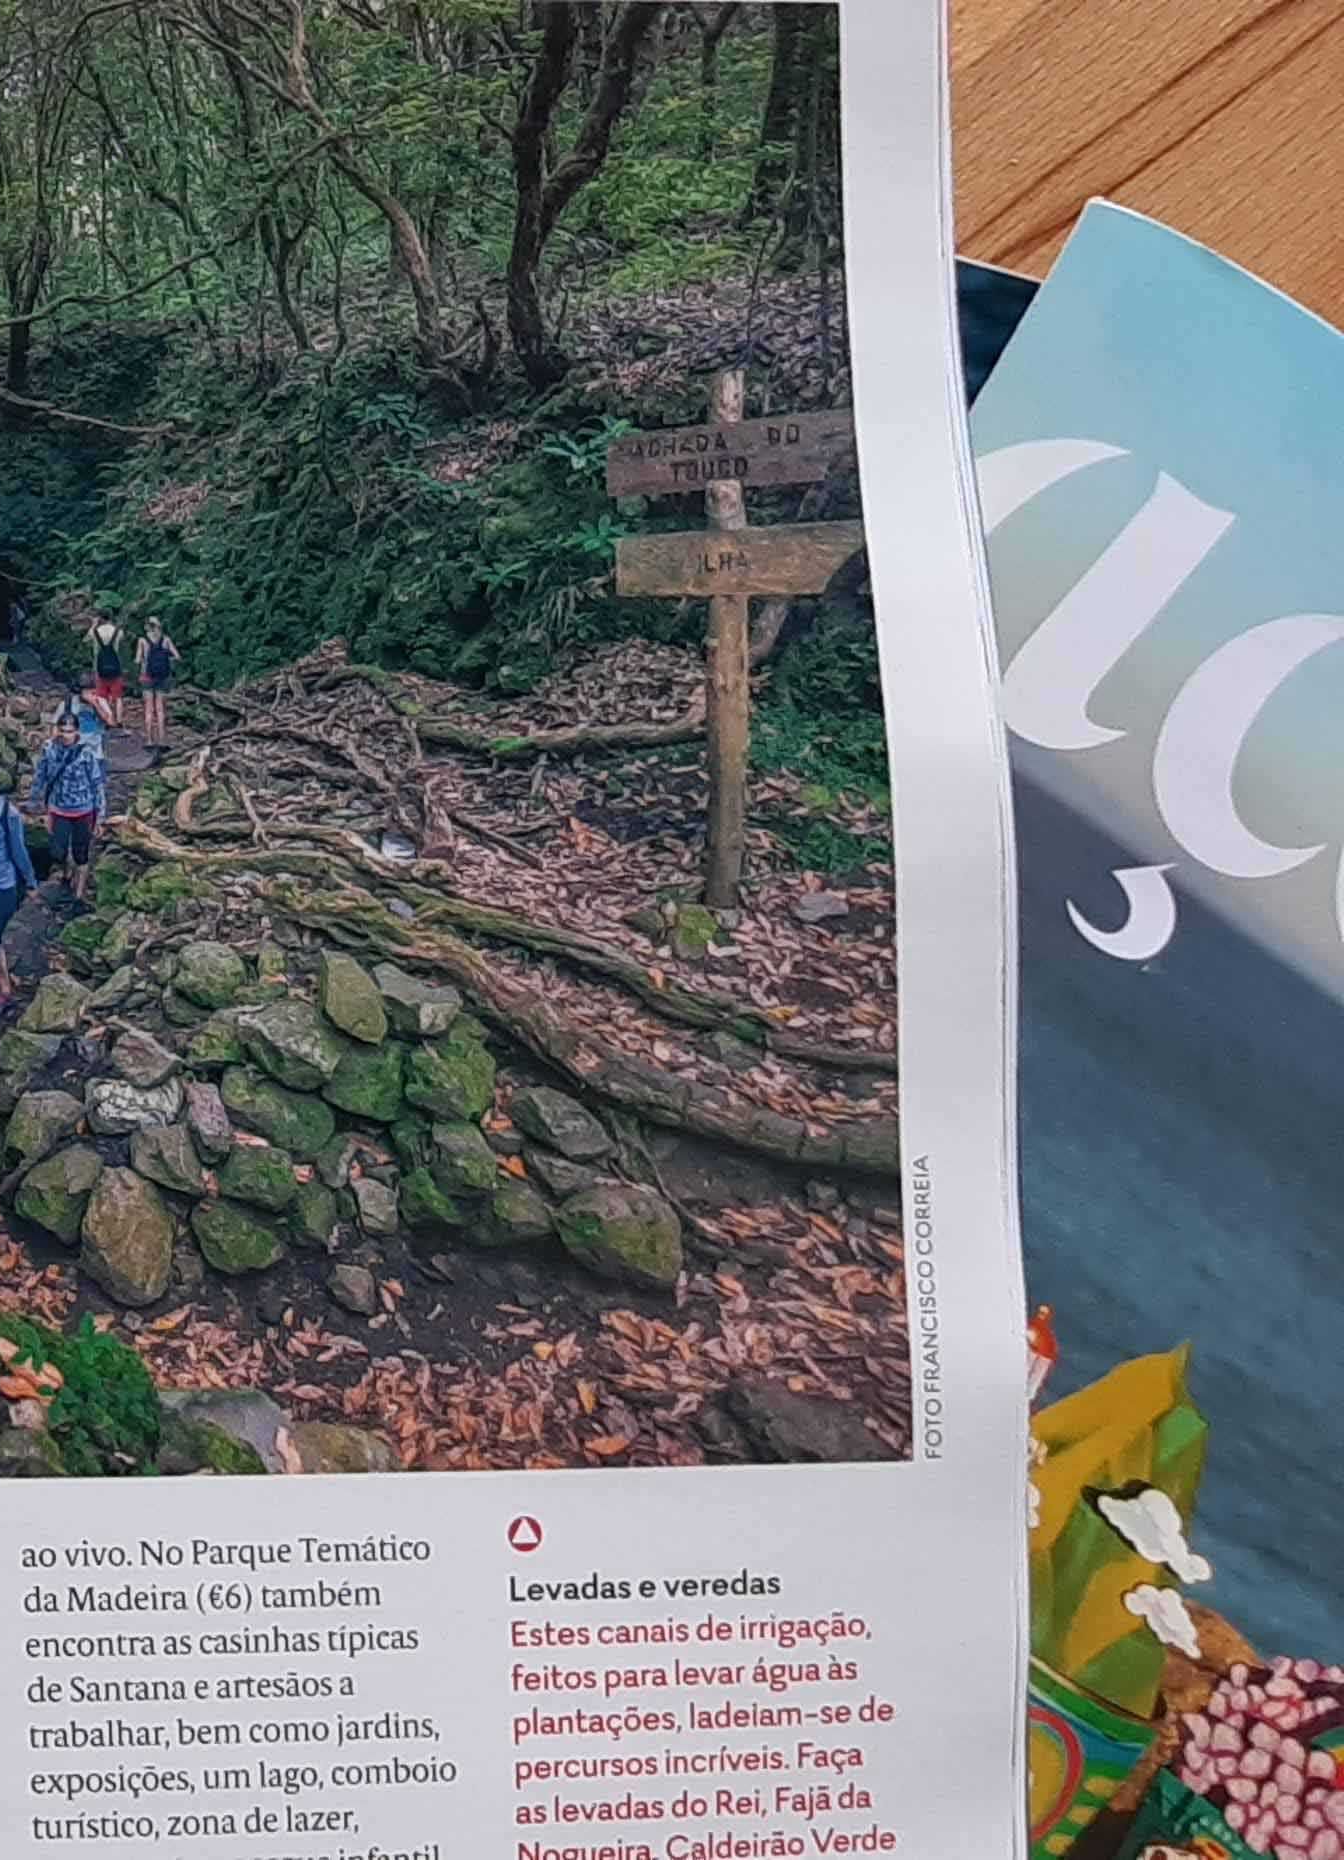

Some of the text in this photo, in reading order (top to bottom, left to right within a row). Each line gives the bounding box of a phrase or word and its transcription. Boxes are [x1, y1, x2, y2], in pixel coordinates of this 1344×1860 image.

[912, 1154, 943, 1460] FOTO FRANCISCO CORREIA
[22, 1535, 430, 1572] ao vivo. No Parque Temático
[24, 1580, 380, 1615] da Madeira (€6) também
[510, 1568, 780, 1602] Levadas e veredas
[511, 1612, 871, 1648] Estes canais de irrigação,
[514, 1696, 893, 1745] plantações, ladeiam-se de
[31, 1756, 456, 1801] exposições, um lago, comboio
[516, 1742, 863, 1790] percursos incríveis. Faça
[32, 1805, 358, 1840] turístico, zona de lazer,
